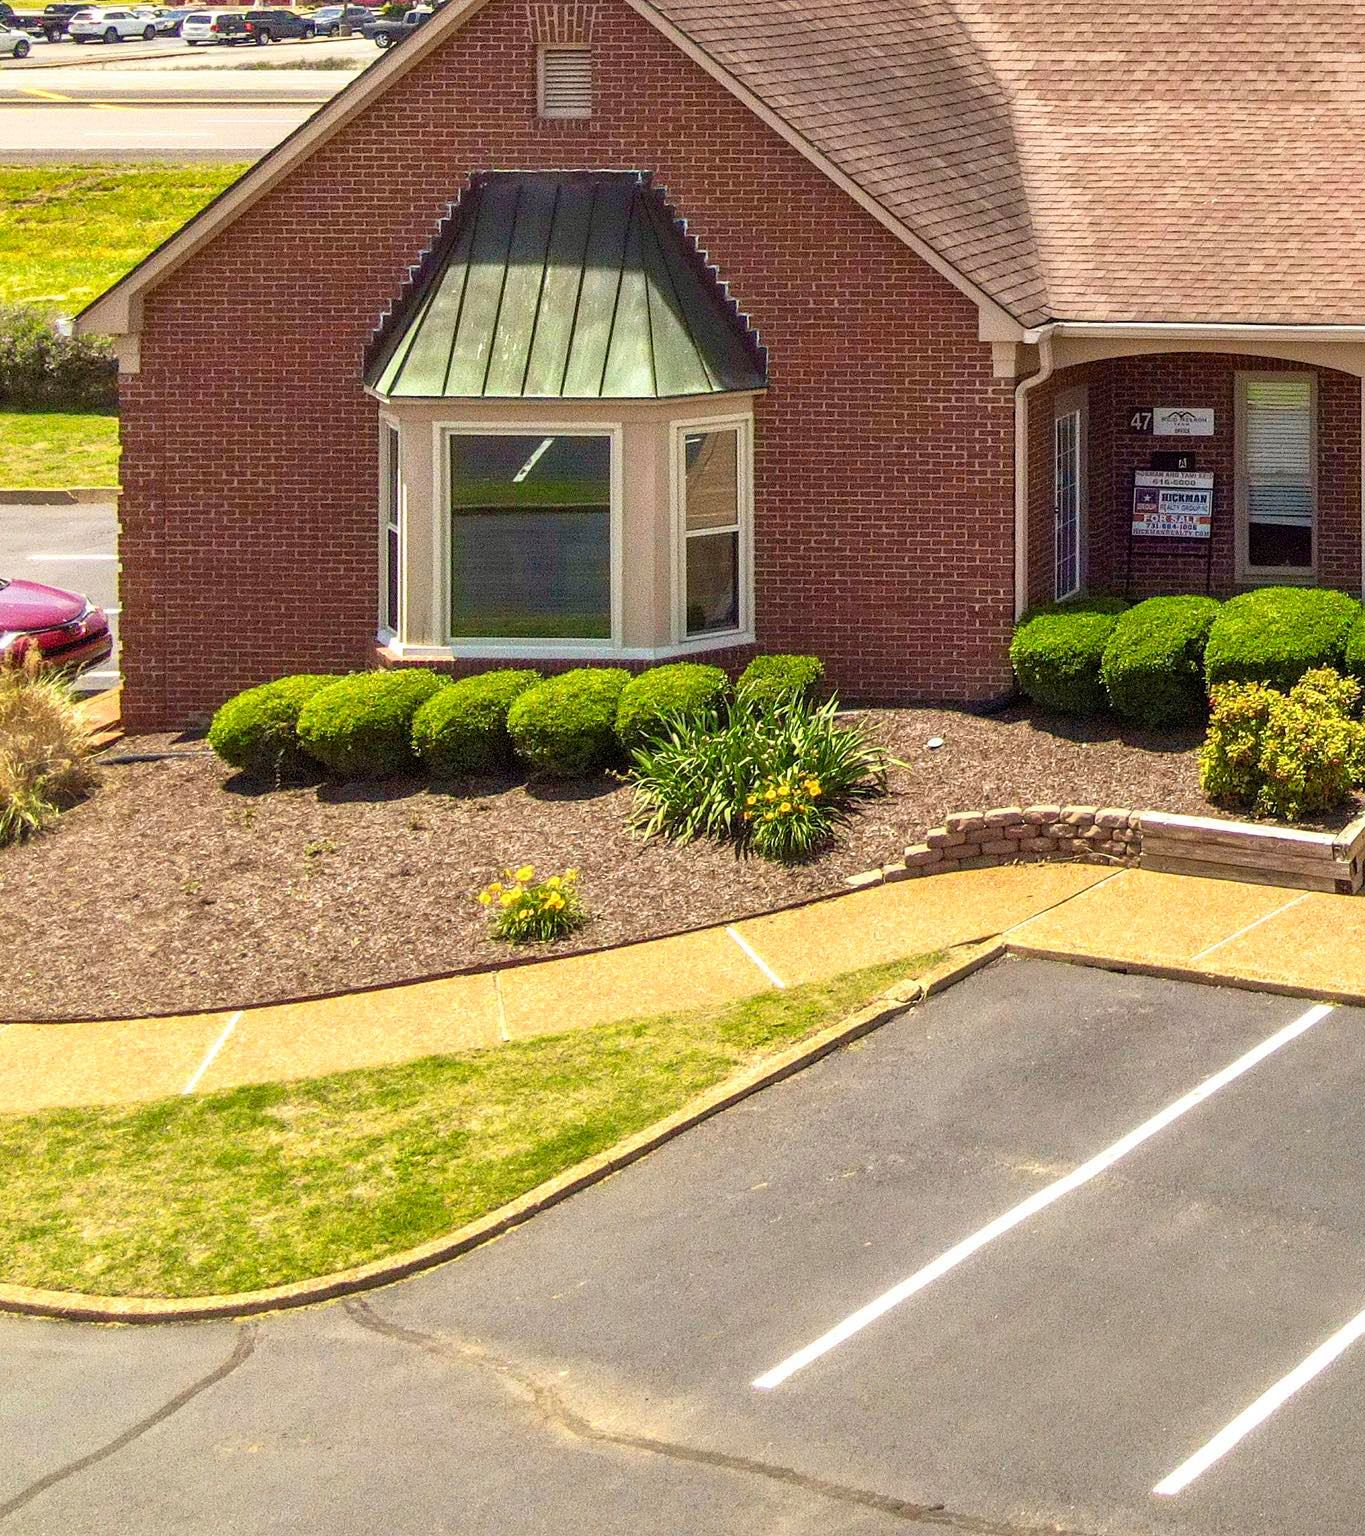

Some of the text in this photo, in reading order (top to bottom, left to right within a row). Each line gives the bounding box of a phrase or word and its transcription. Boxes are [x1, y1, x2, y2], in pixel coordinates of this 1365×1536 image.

[1130, 412, 1152, 431] 47
[1178, 457, 1187, 469] A
[1161, 493, 1208, 503] HICKMAN
[1144, 514, 1200, 524] FOR SALE
